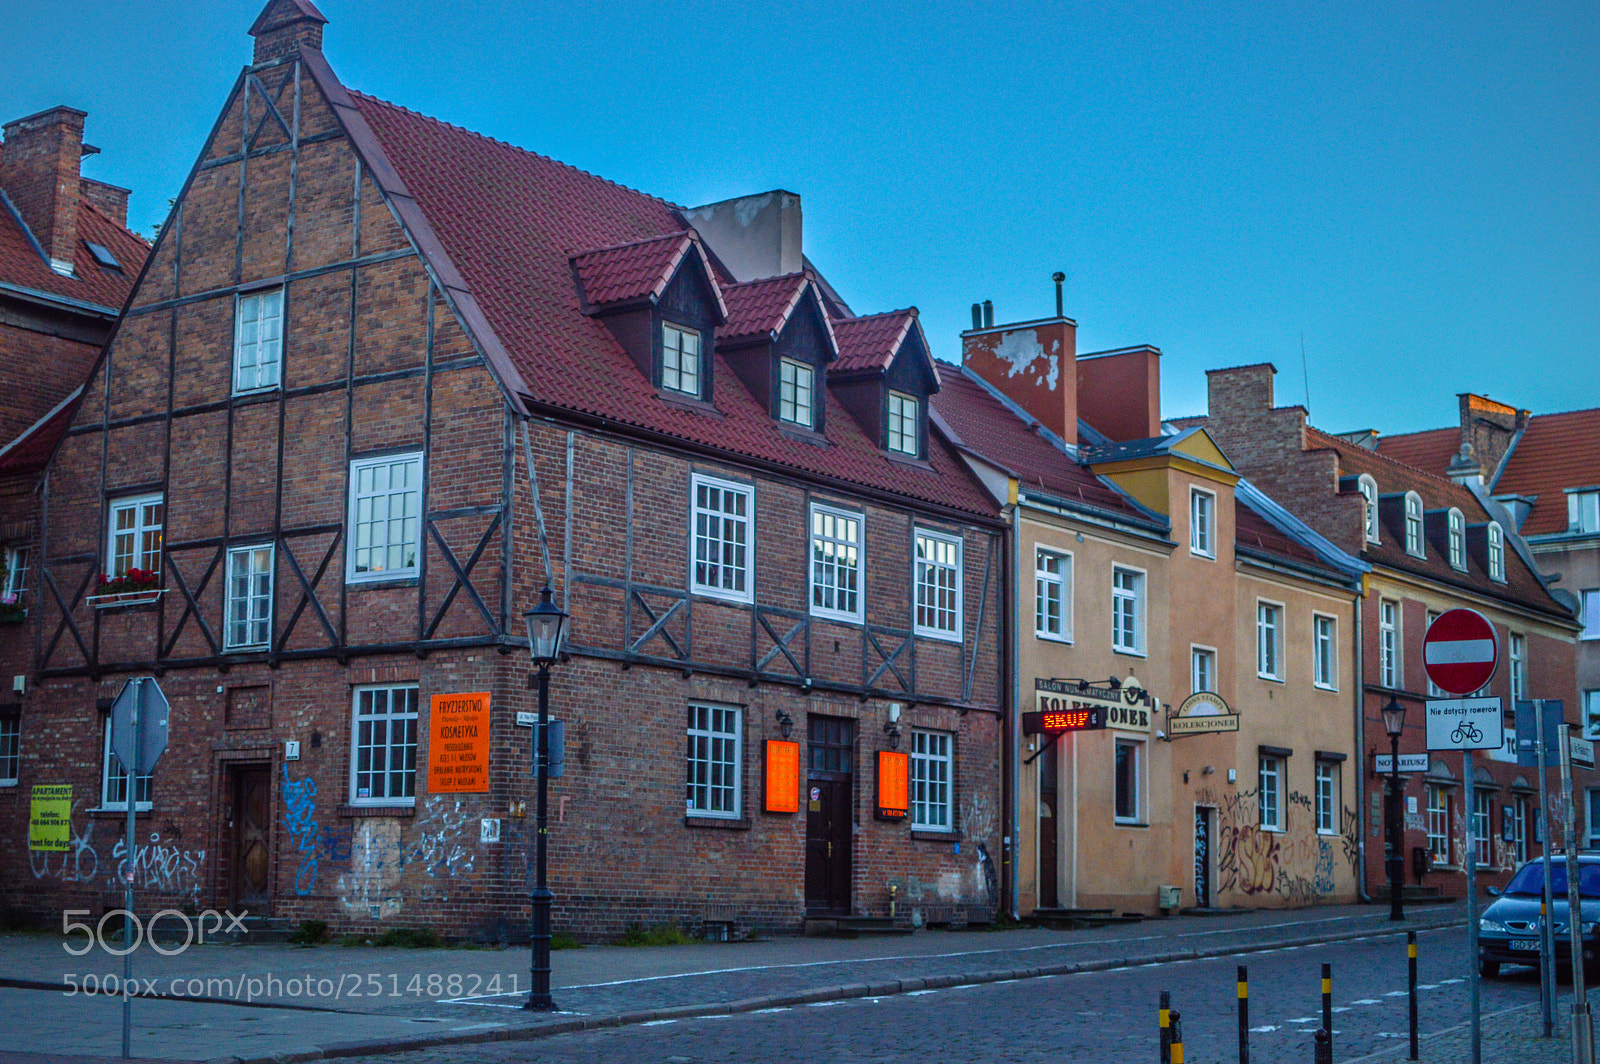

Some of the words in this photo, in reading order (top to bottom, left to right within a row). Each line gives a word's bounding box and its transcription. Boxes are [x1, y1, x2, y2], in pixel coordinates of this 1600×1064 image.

[1039, 680, 1062, 691] SALON
[1064, 685, 1119, 699] NUMZMATYCZNY
[439, 699, 483, 714] FRYZJERSTWO
[1430, 707, 1441, 716] Nie
[1443, 707, 1467, 716] dotyczy
[1469, 704, 1498, 714] rowerów
[1173, 719, 1236, 729] KOLEKCJONER
[440, 725, 478, 739] KOSMETYKA
[290, 743, 295, 754] 7
[1378, 758, 1427, 767] NOARIUSZ
[32, 787, 72, 795] APARTAMENT
[44, 838, 53, 846] for
[54, 838, 70, 848] days
